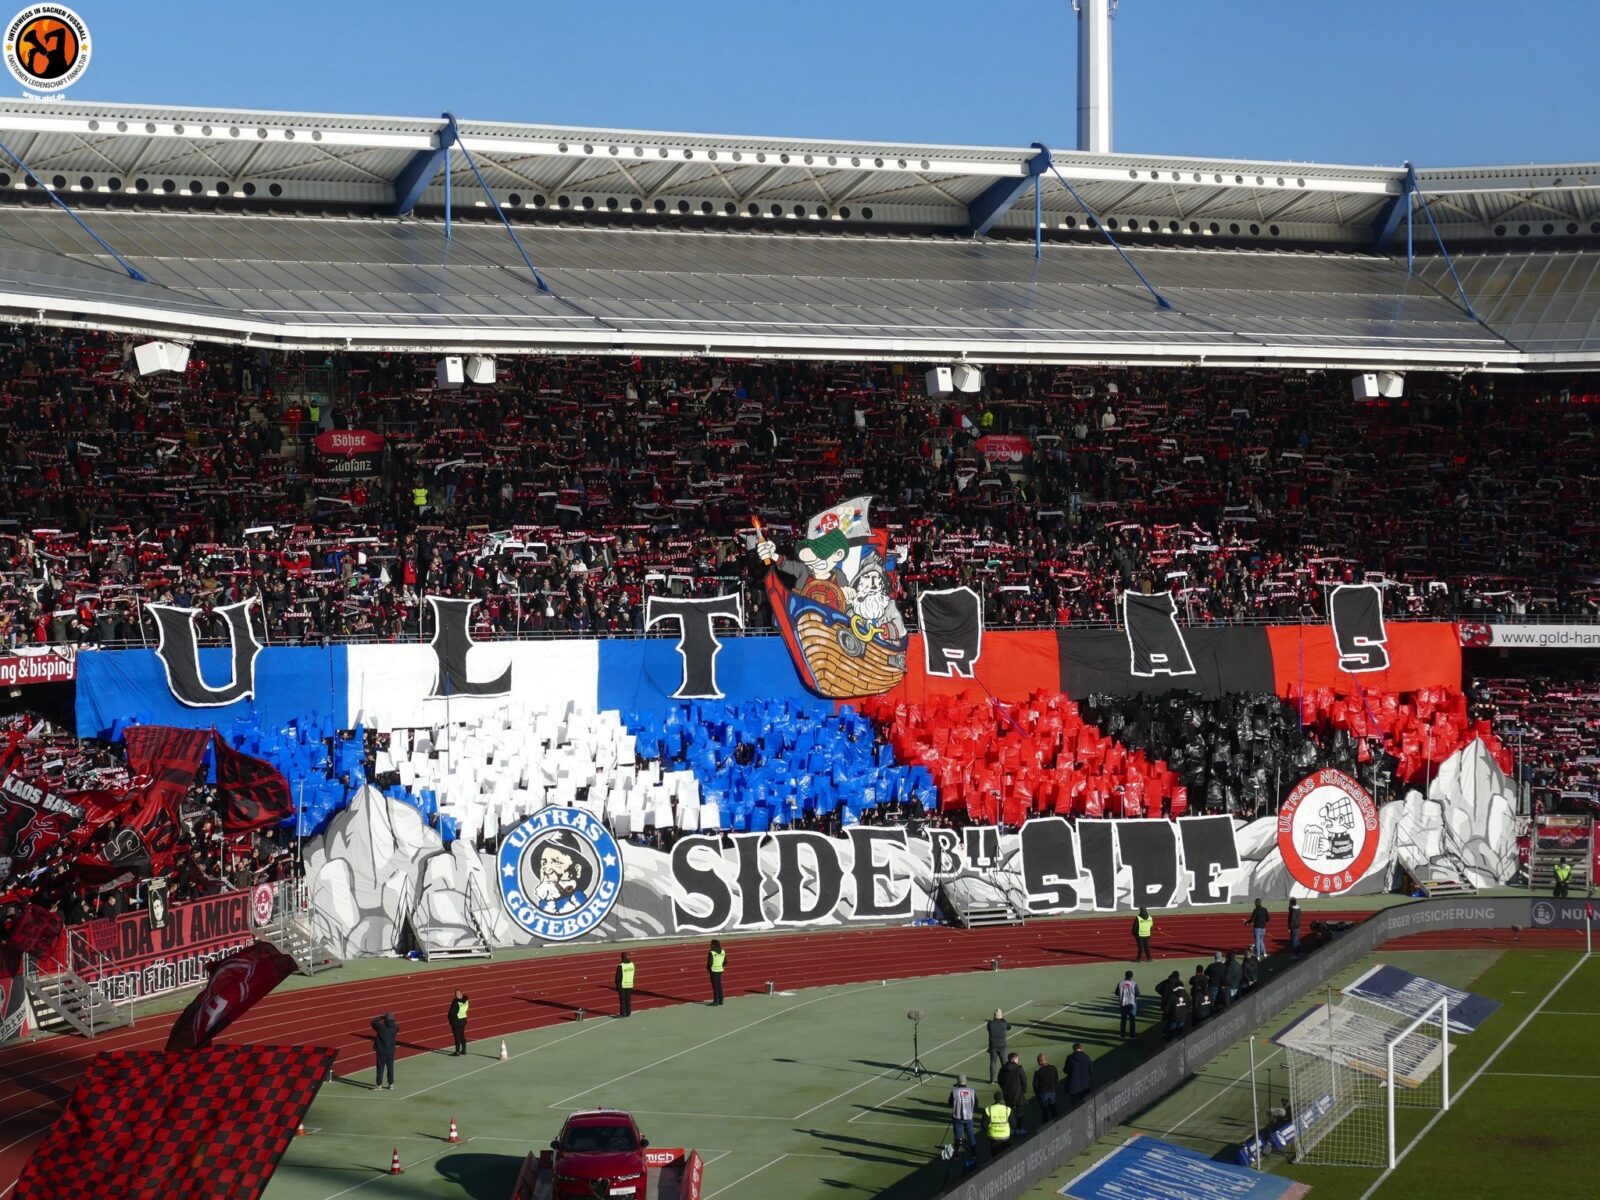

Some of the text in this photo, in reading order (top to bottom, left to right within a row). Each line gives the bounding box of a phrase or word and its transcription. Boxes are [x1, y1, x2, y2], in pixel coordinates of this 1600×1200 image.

[1502, 631, 1600, 646] www.gold-han
[2, 773, 43, 804] KAOS
[1279, 769, 1378, 833] ULTRAS NÜRNBERG
[508, 809, 603, 848] ULTRAS
[670, 825, 915, 932] SIDE
[1019, 813, 1241, 914] SIDE
[1313, 871, 1352, 890] 1994
[190, 895, 250, 943] AMICI
[507, 880, 615, 936] GÖTEBORG
[1411, 907, 1495, 925] VERSICHERUNG
[143, 958, 176, 994] FÜR
